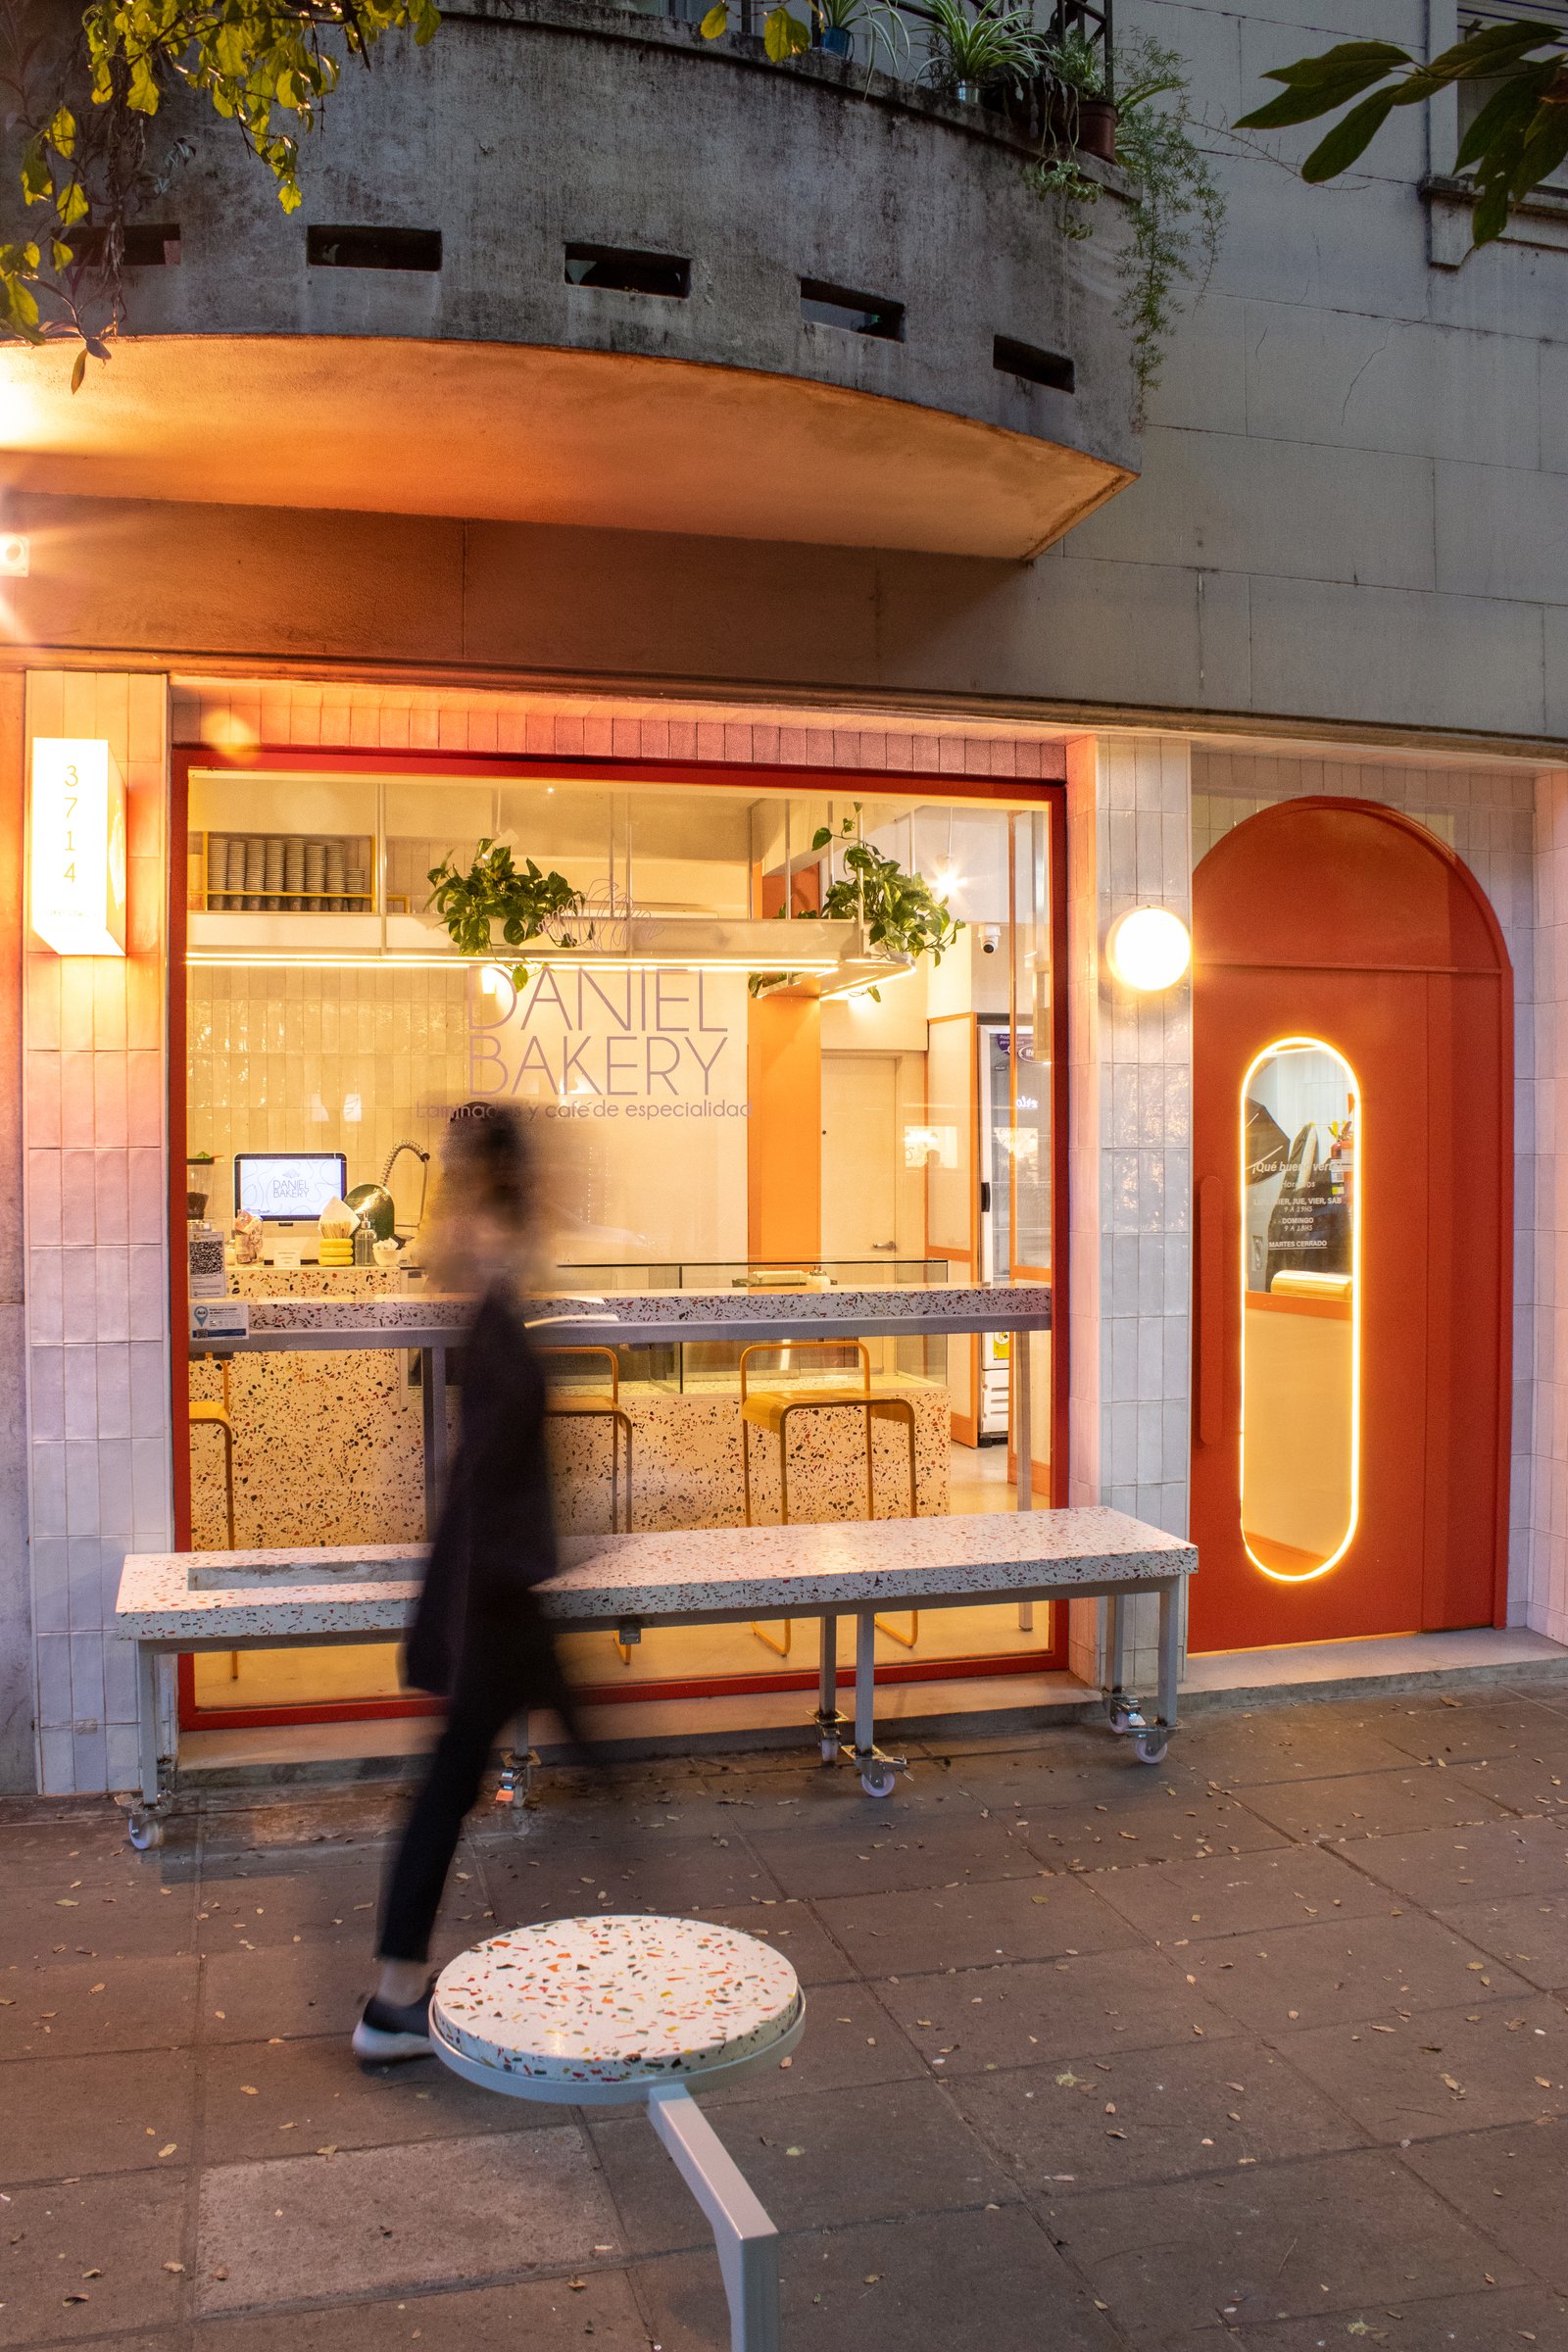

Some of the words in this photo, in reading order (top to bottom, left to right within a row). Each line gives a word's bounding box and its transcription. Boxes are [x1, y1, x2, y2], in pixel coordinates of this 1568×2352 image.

[64, 764, 78, 883] 3714
[467, 965, 728, 1032] DANIEL
[468, 1035, 728, 1096] BAKERY
[528, 1105, 539, 1121] y
[545, 1100, 592, 1118] café
[593, 1100, 619, 1117] de
[625, 1099, 753, 1120] especialidad
[272, 1179, 310, 1190] DANIEL
[272, 1189, 310, 1199] BAKERY
